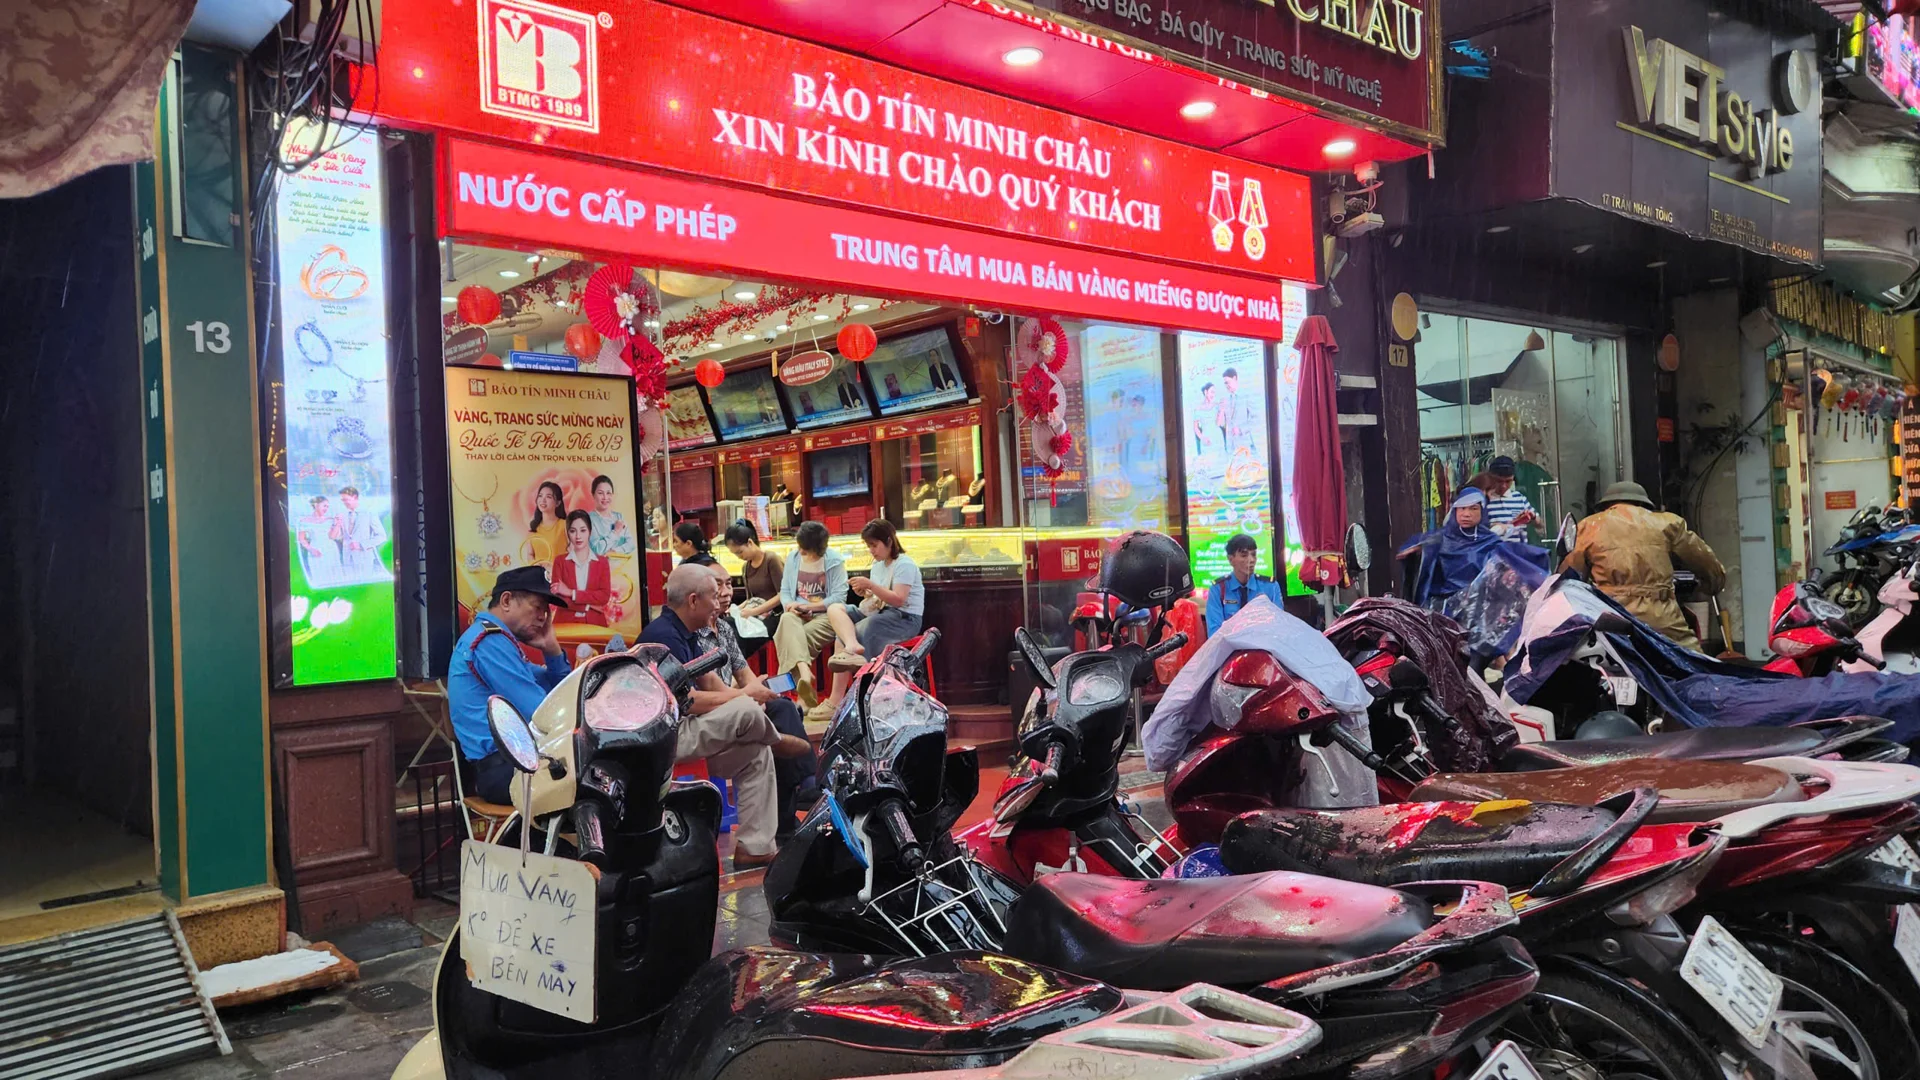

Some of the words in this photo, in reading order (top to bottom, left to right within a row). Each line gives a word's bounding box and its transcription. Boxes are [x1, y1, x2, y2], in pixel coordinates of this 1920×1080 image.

[1161, 11, 1187, 38] ĐÁ
[1233, 35, 1287, 71] TRANG
[1290, 54, 1320, 81] SỨC
[1323, 65, 1344, 89] MỸ
[1346, 79, 1382, 108] NGHỆ
[497, 87, 541, 110] BTMC
[547, 97, 583, 118] 1989
[792, 72, 871, 122] BẢO
[877, 92, 936, 138] TÍN
[944, 112, 1028, 160] MINH
[1034, 137, 1111, 178] CHÂU
[712, 108, 784, 156] XIN
[795, 125, 890, 177] KÍNH
[898, 151, 992, 198] CHÀO
[998, 173, 1061, 211] QUÝ
[1067, 186, 1161, 231] KHÁCH
[1655, 206, 1673, 223] TÔNG
[458, 172, 570, 217] NƯỚC
[655, 204, 737, 241] PHÉP
[831, 233, 919, 270] TRUNG
[924, 244, 972, 278] TÂM
[979, 256, 1026, 286] MUA
[1031, 261, 1073, 292] BÁN
[1078, 268, 1129, 301] VÀNG
[1196, 290, 1244, 320] ĐƯỢC
[1247, 296, 1281, 322] NHÀ
[186, 320, 232, 355] 13
[1393, 347, 1404, 363] 17
[491, 384, 518, 397] BẢO
[520, 384, 541, 398] TÍN
[543, 387, 576, 399] MINH
[579, 388, 611, 401] CHÂU
[454, 407, 492, 426] VÀNG,
[494, 411, 534, 426] TRANG
[536, 410, 559, 427] SỨC
[561, 411, 594, 428] MỪNG
[596, 412, 625, 429] NGÀY
[459, 428, 500, 451] Quốc
[504, 429, 527, 450] Tế
[528, 431, 565, 453] Phụ
[566, 431, 595, 451] Nữ
[595, 433, 624, 453] 8/3
[465, 453, 489, 462] THAY
[490, 452, 505, 462] LỜI
[527, 453, 541, 463] ƠN
[542, 454, 565, 464] TRỌN
[530, 932, 555, 956] XE
[491, 955, 529, 985] BÊN
